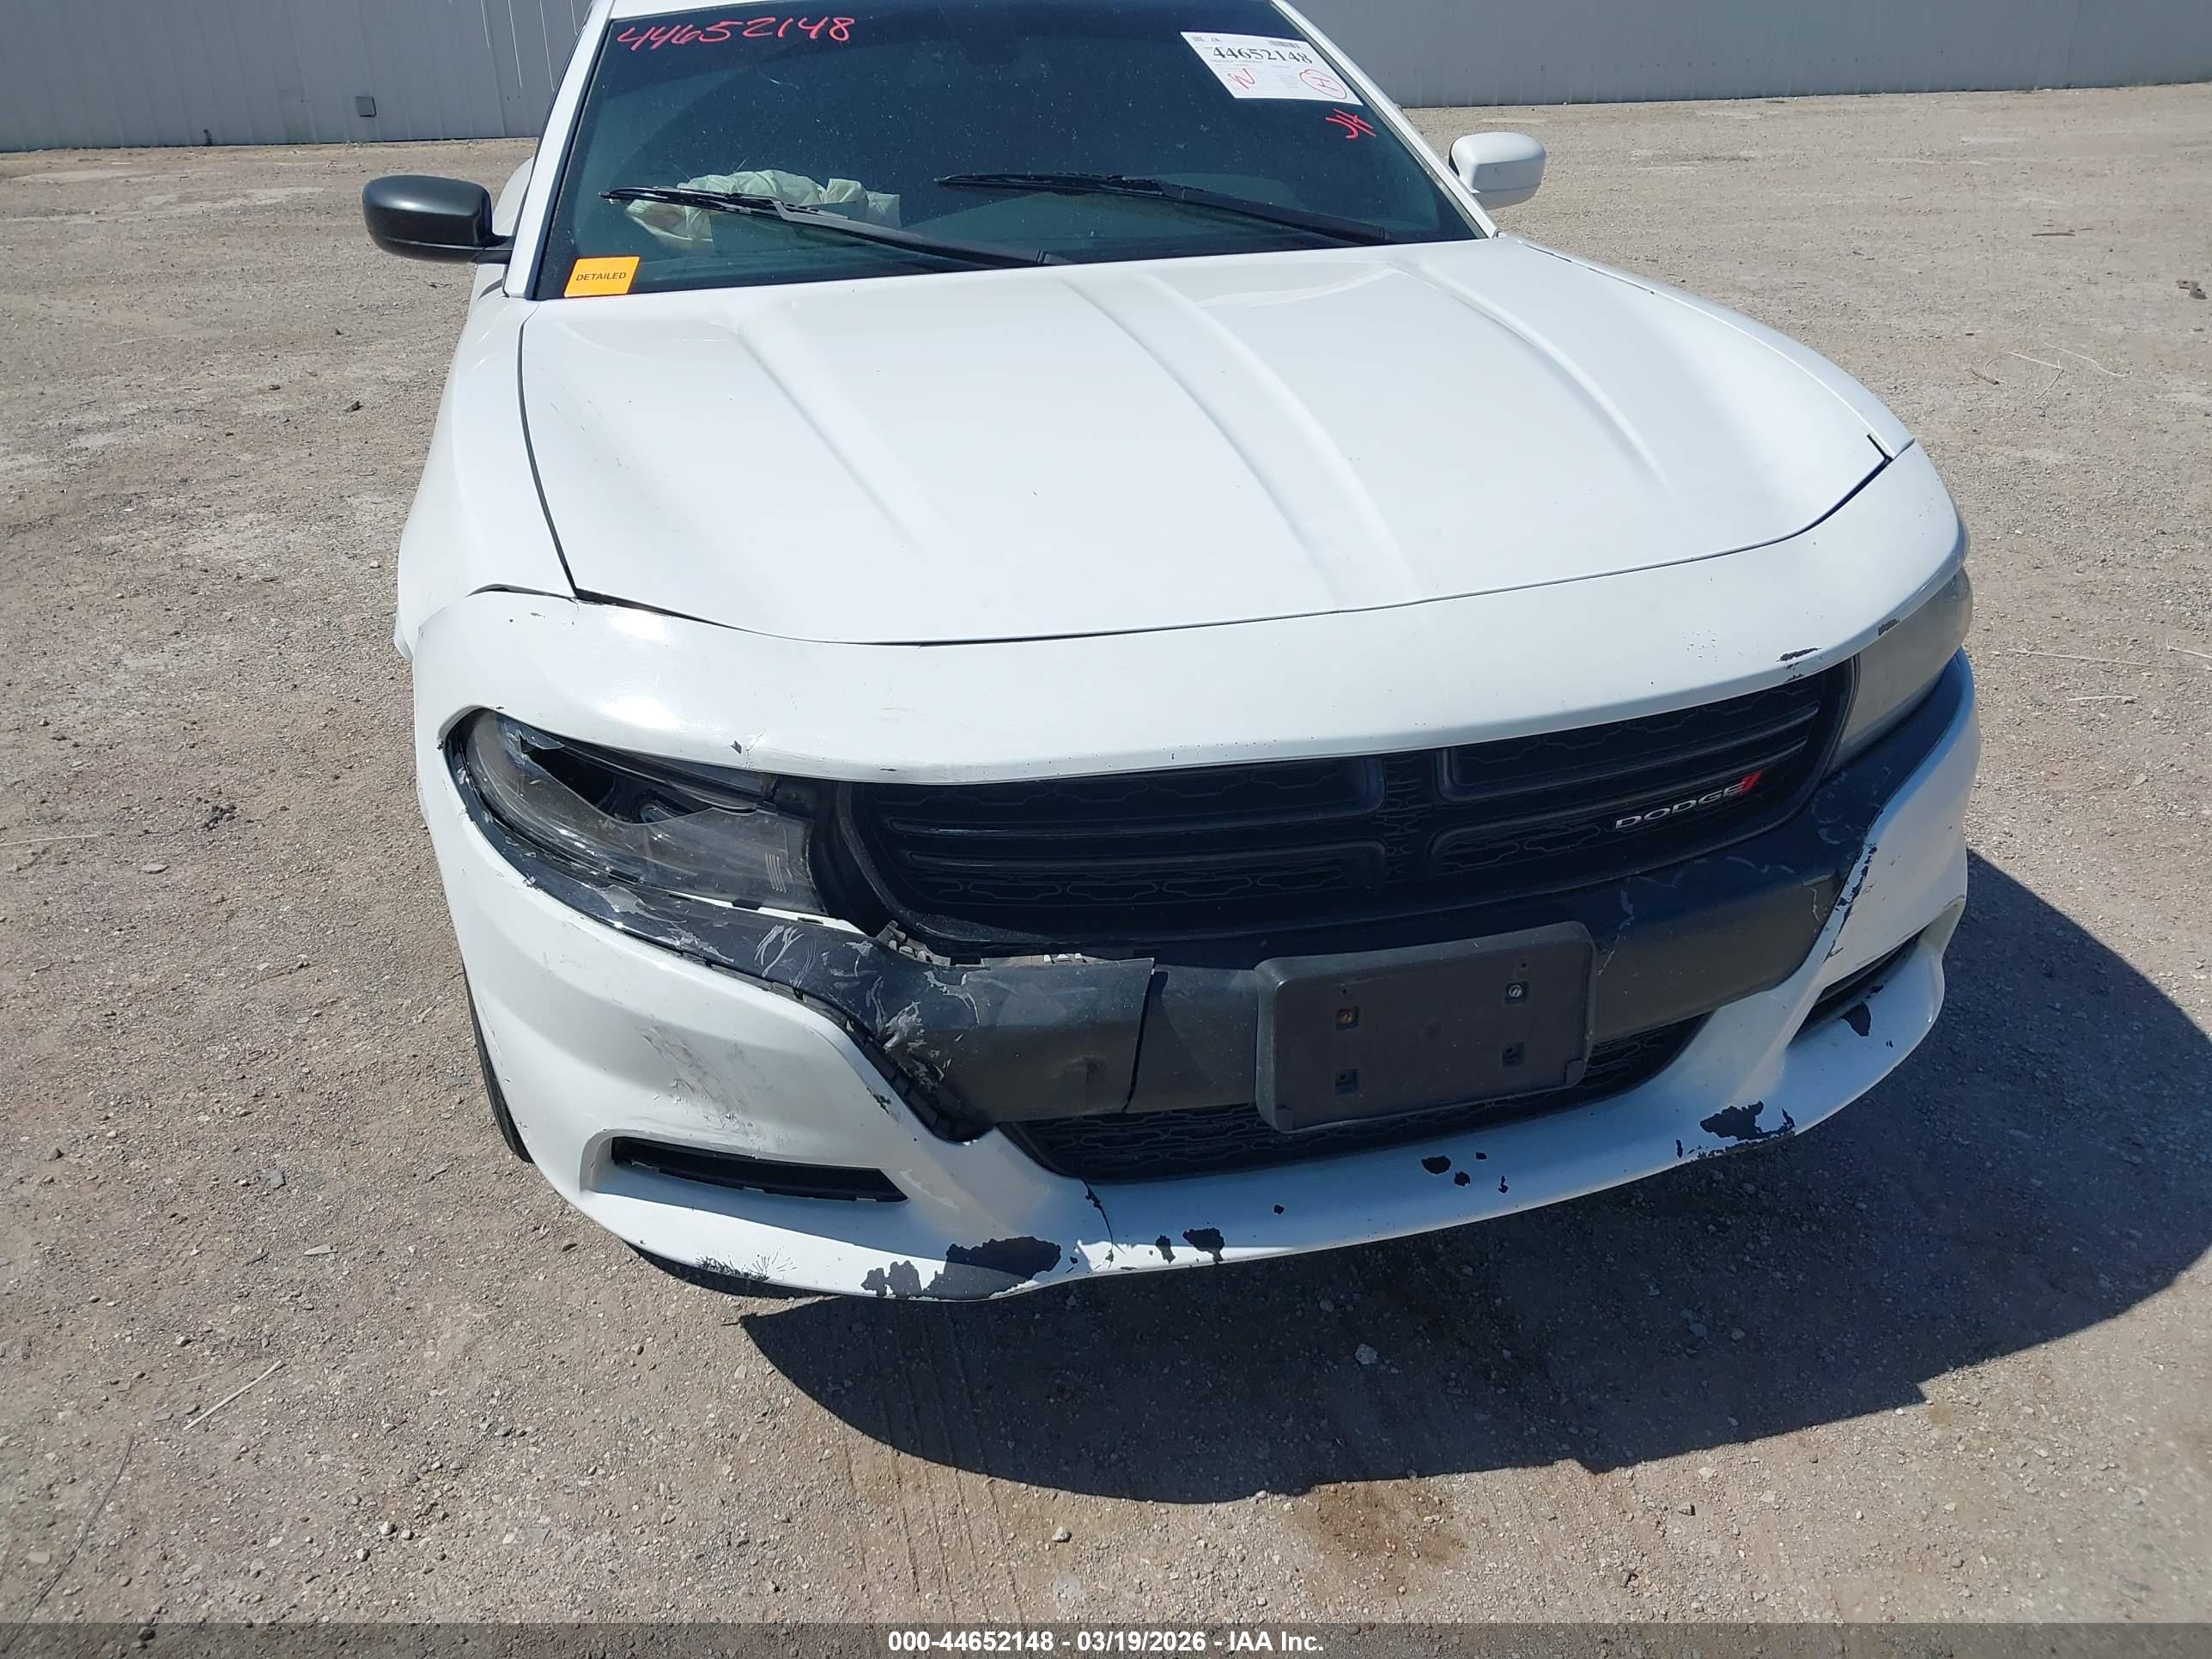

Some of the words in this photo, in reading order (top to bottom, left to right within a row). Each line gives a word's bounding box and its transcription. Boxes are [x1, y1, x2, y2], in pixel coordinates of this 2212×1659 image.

[617, 16, 855, 51] 44652148
[1212, 46, 1314, 64] 44652148
[575, 271, 628, 282] DETAILED
[1614, 781, 1747, 830] DODGE
